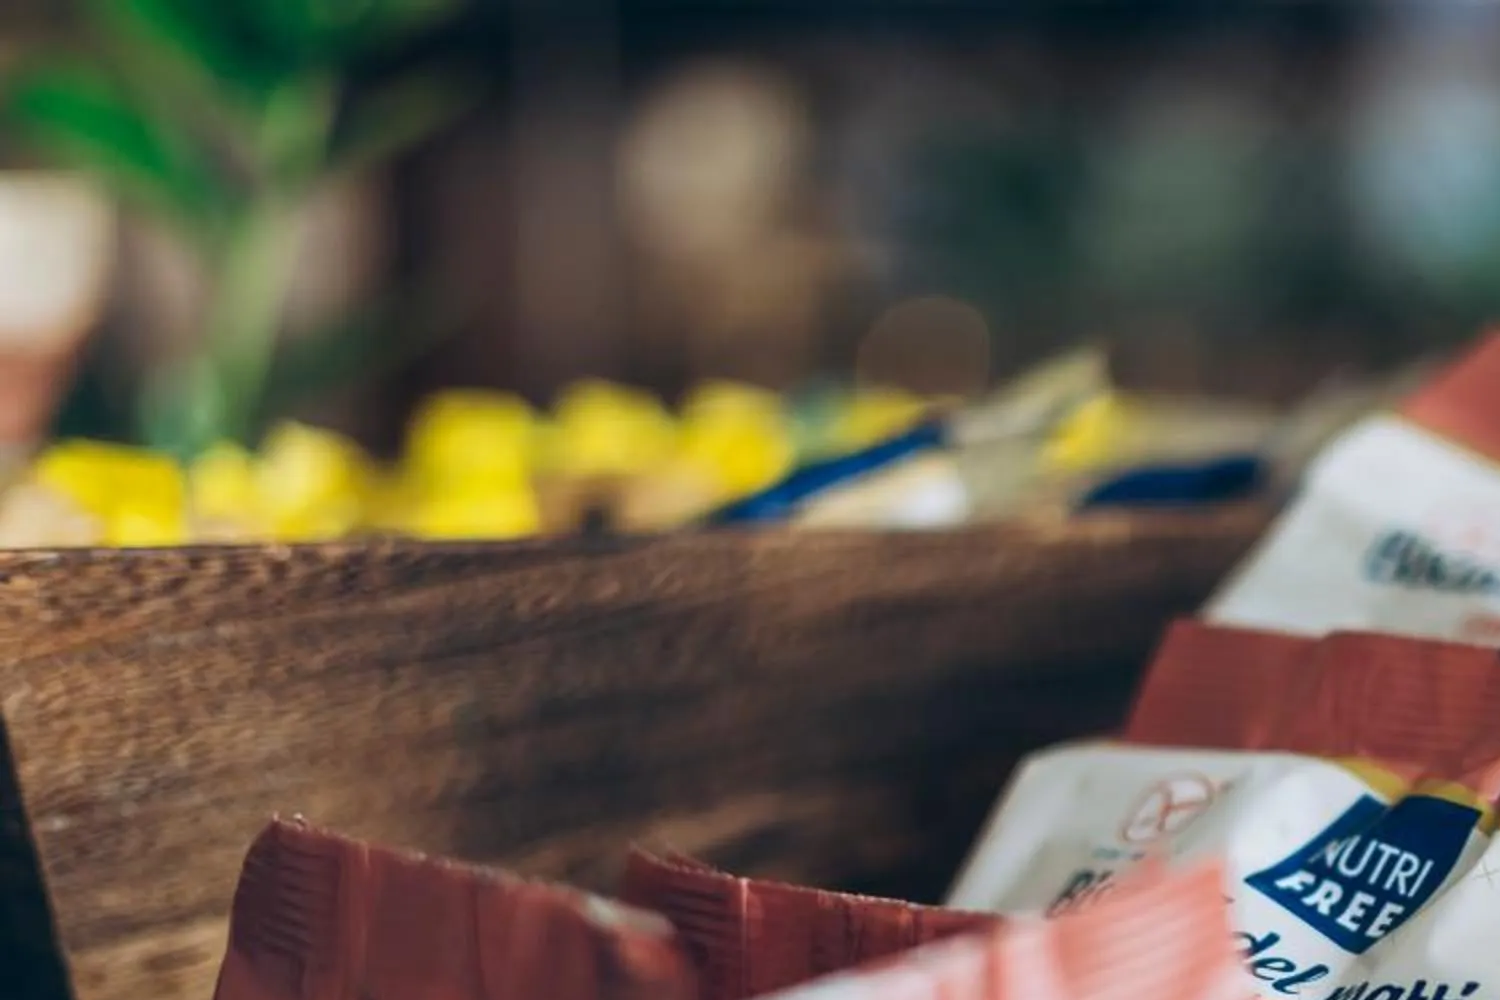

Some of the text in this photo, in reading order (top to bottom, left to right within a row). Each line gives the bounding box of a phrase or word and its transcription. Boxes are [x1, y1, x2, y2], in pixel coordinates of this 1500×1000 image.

[1308, 834, 1435, 898] NUTRI
[1274, 869, 1405, 938] FREE
[1236, 930, 1330, 995] del
